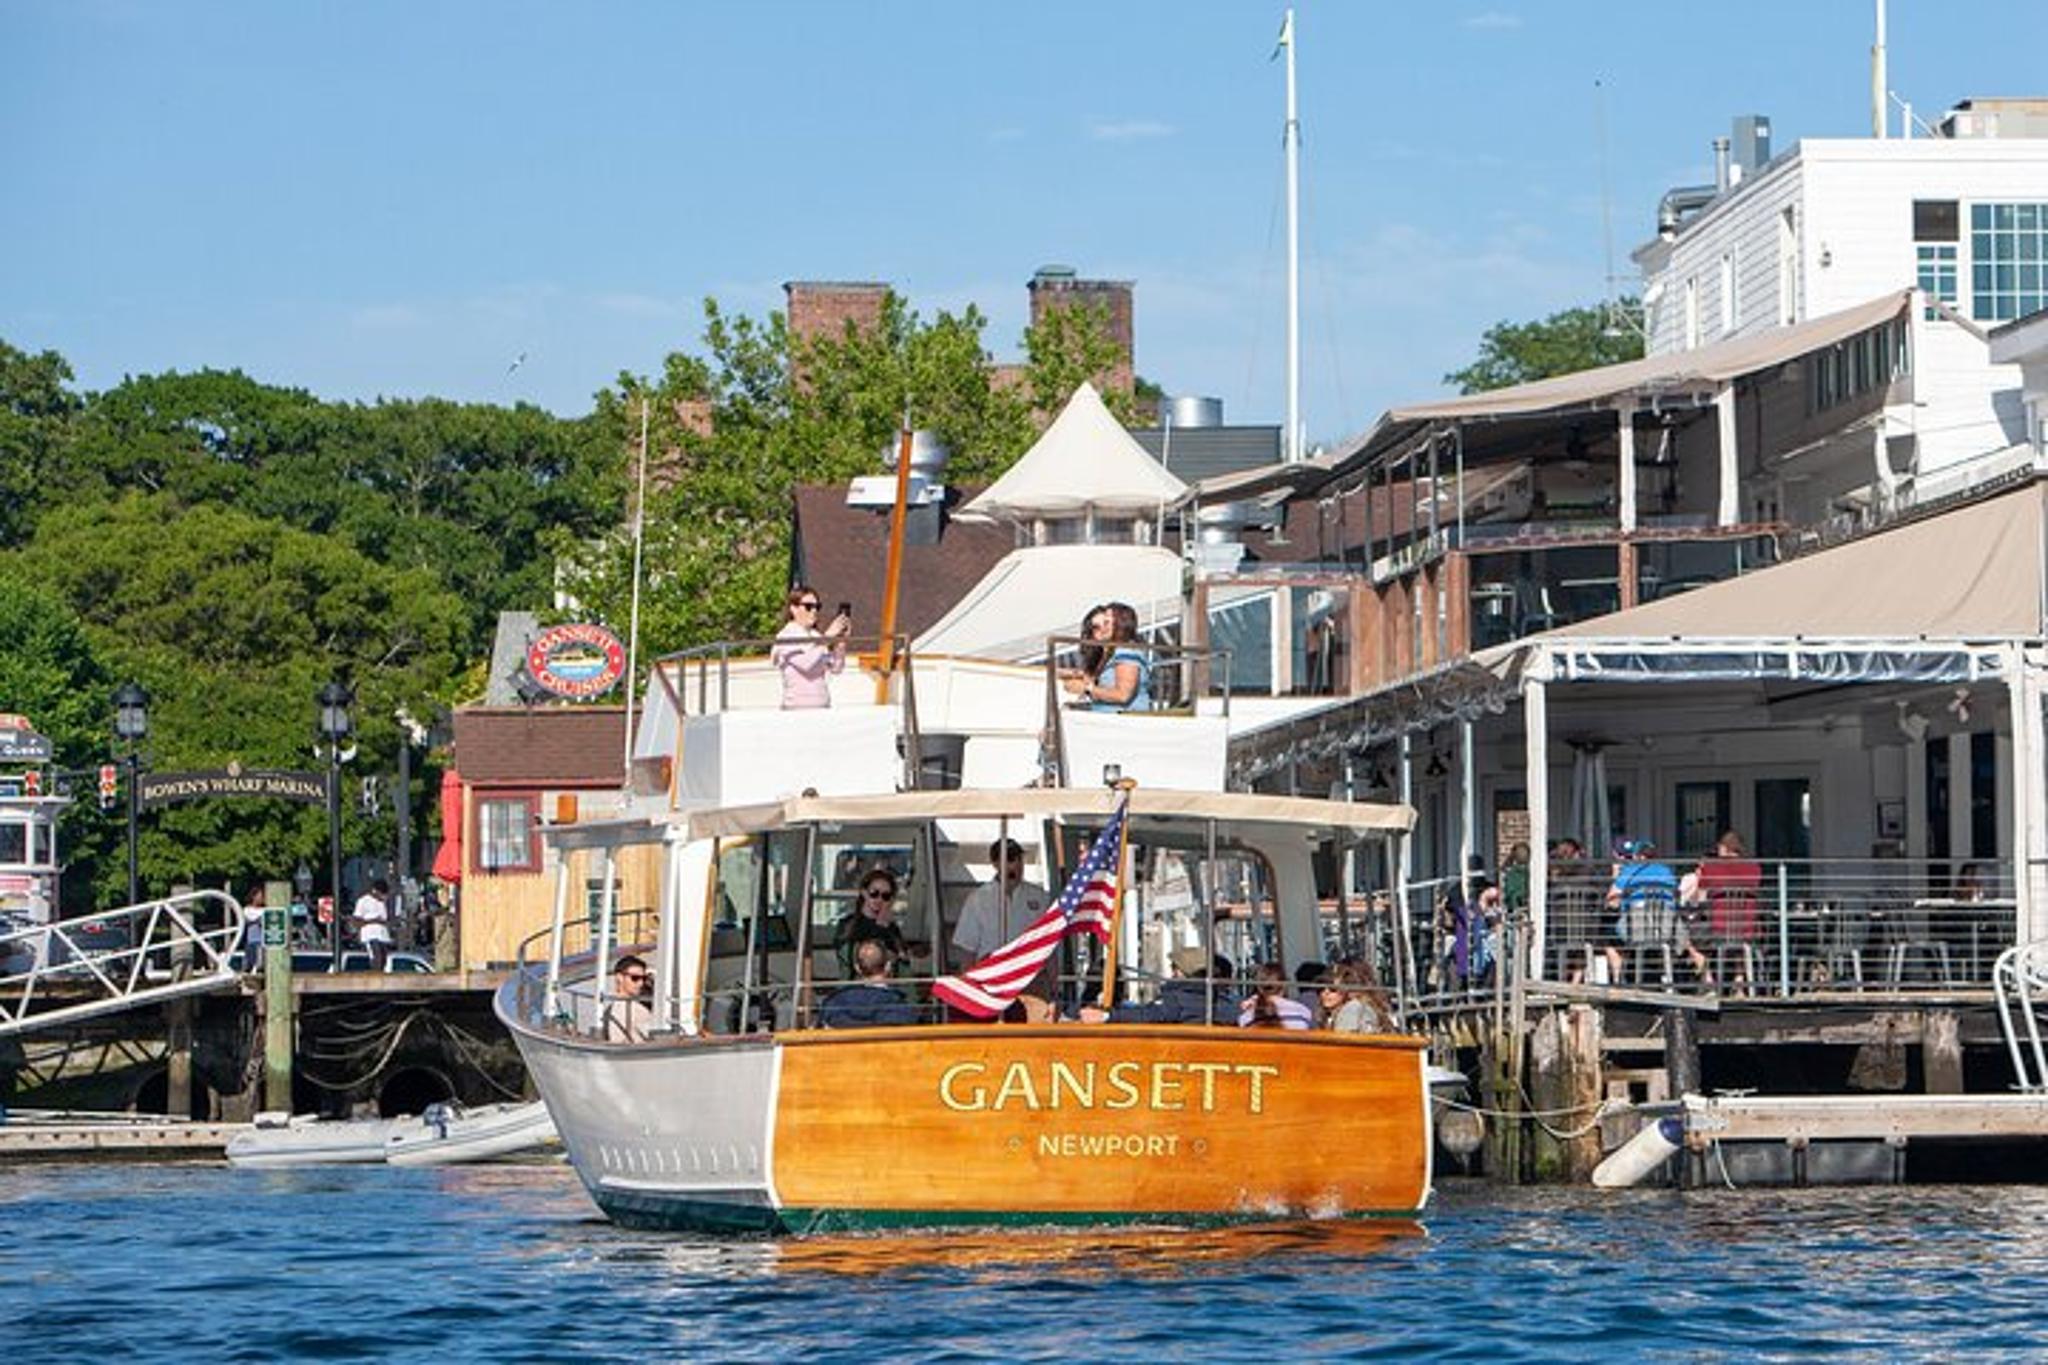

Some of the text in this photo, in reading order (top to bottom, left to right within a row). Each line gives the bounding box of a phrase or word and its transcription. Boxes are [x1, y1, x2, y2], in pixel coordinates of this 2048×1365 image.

[144, 777, 325, 800] BOWEN'S WHARF MARINA
[938, 1061, 1281, 1115] GANSETT
[1038, 1134, 1181, 1157] NEWPORT
